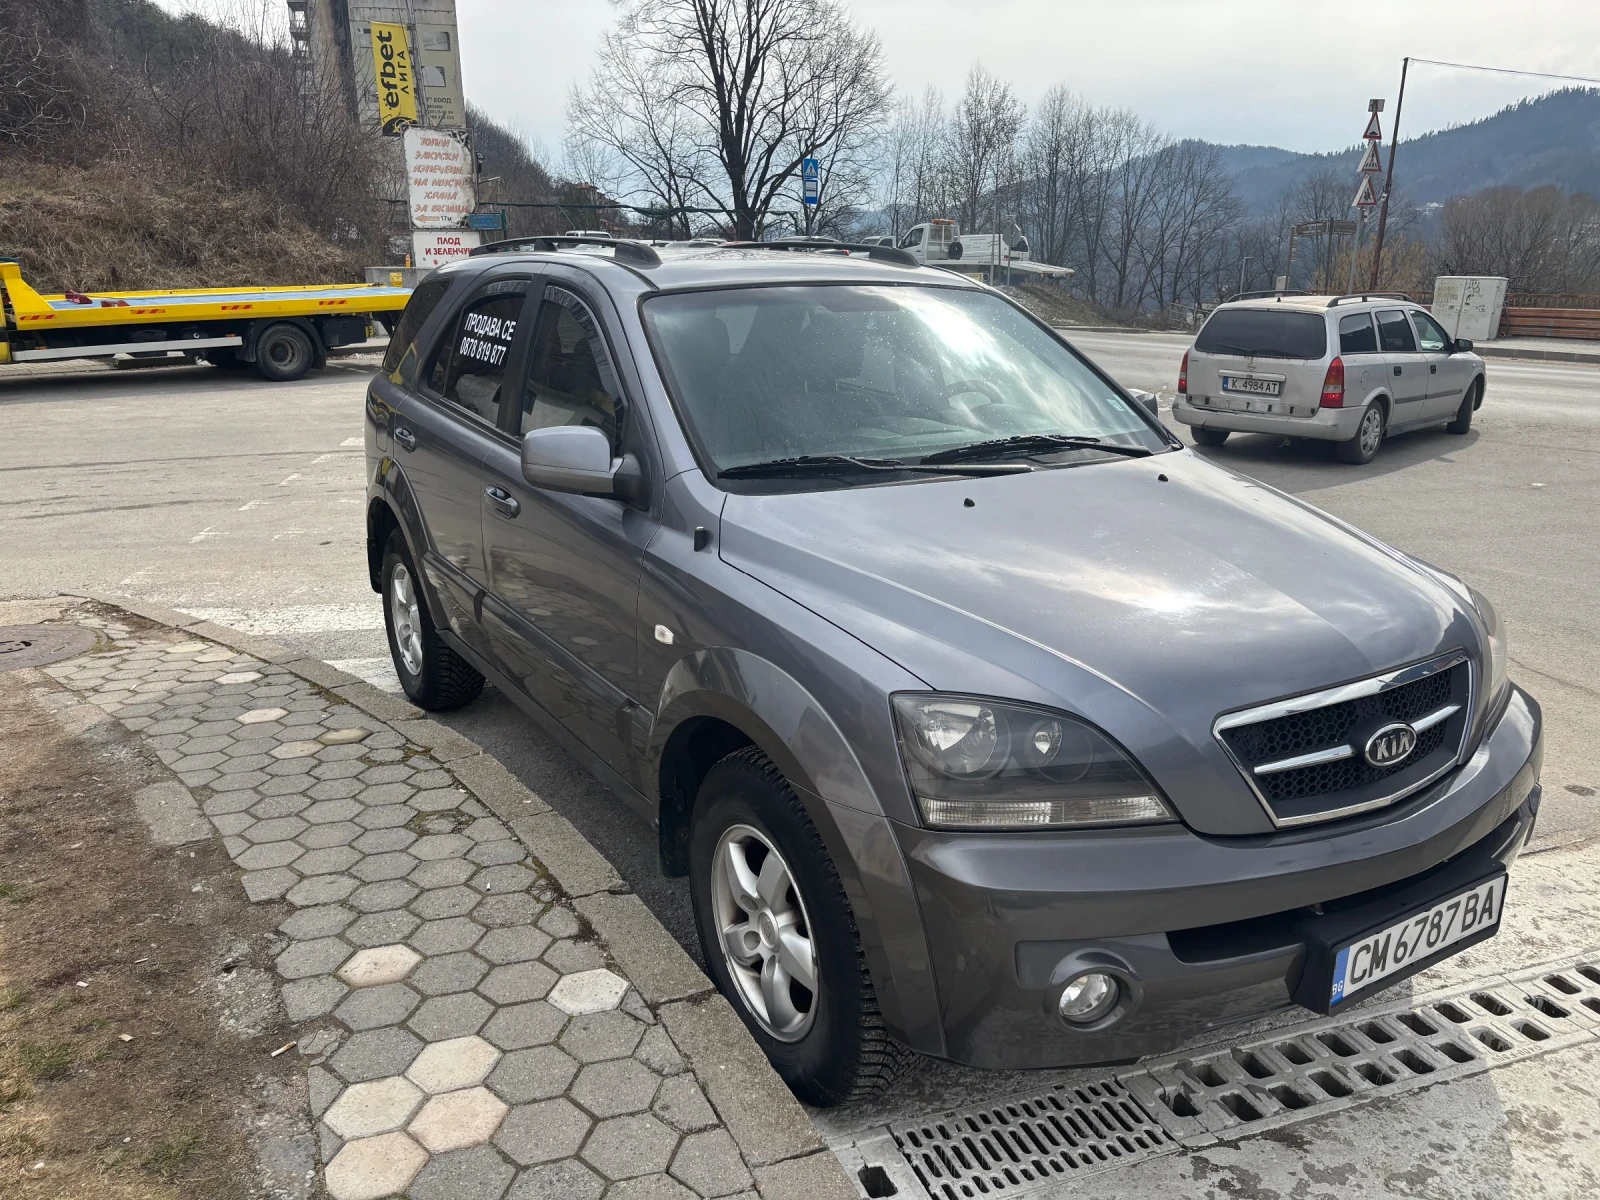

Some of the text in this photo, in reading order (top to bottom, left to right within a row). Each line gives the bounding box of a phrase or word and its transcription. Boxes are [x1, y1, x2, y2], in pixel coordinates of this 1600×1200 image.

[396, 50, 410, 95] ЛИГА
[437, 236, 461, 246] ПЛОД
[464, 313, 517, 341] ПРОДАВА СЕ
[460, 336, 507, 365] 0878 819 877
[1375, 731, 1410, 760] KIA
